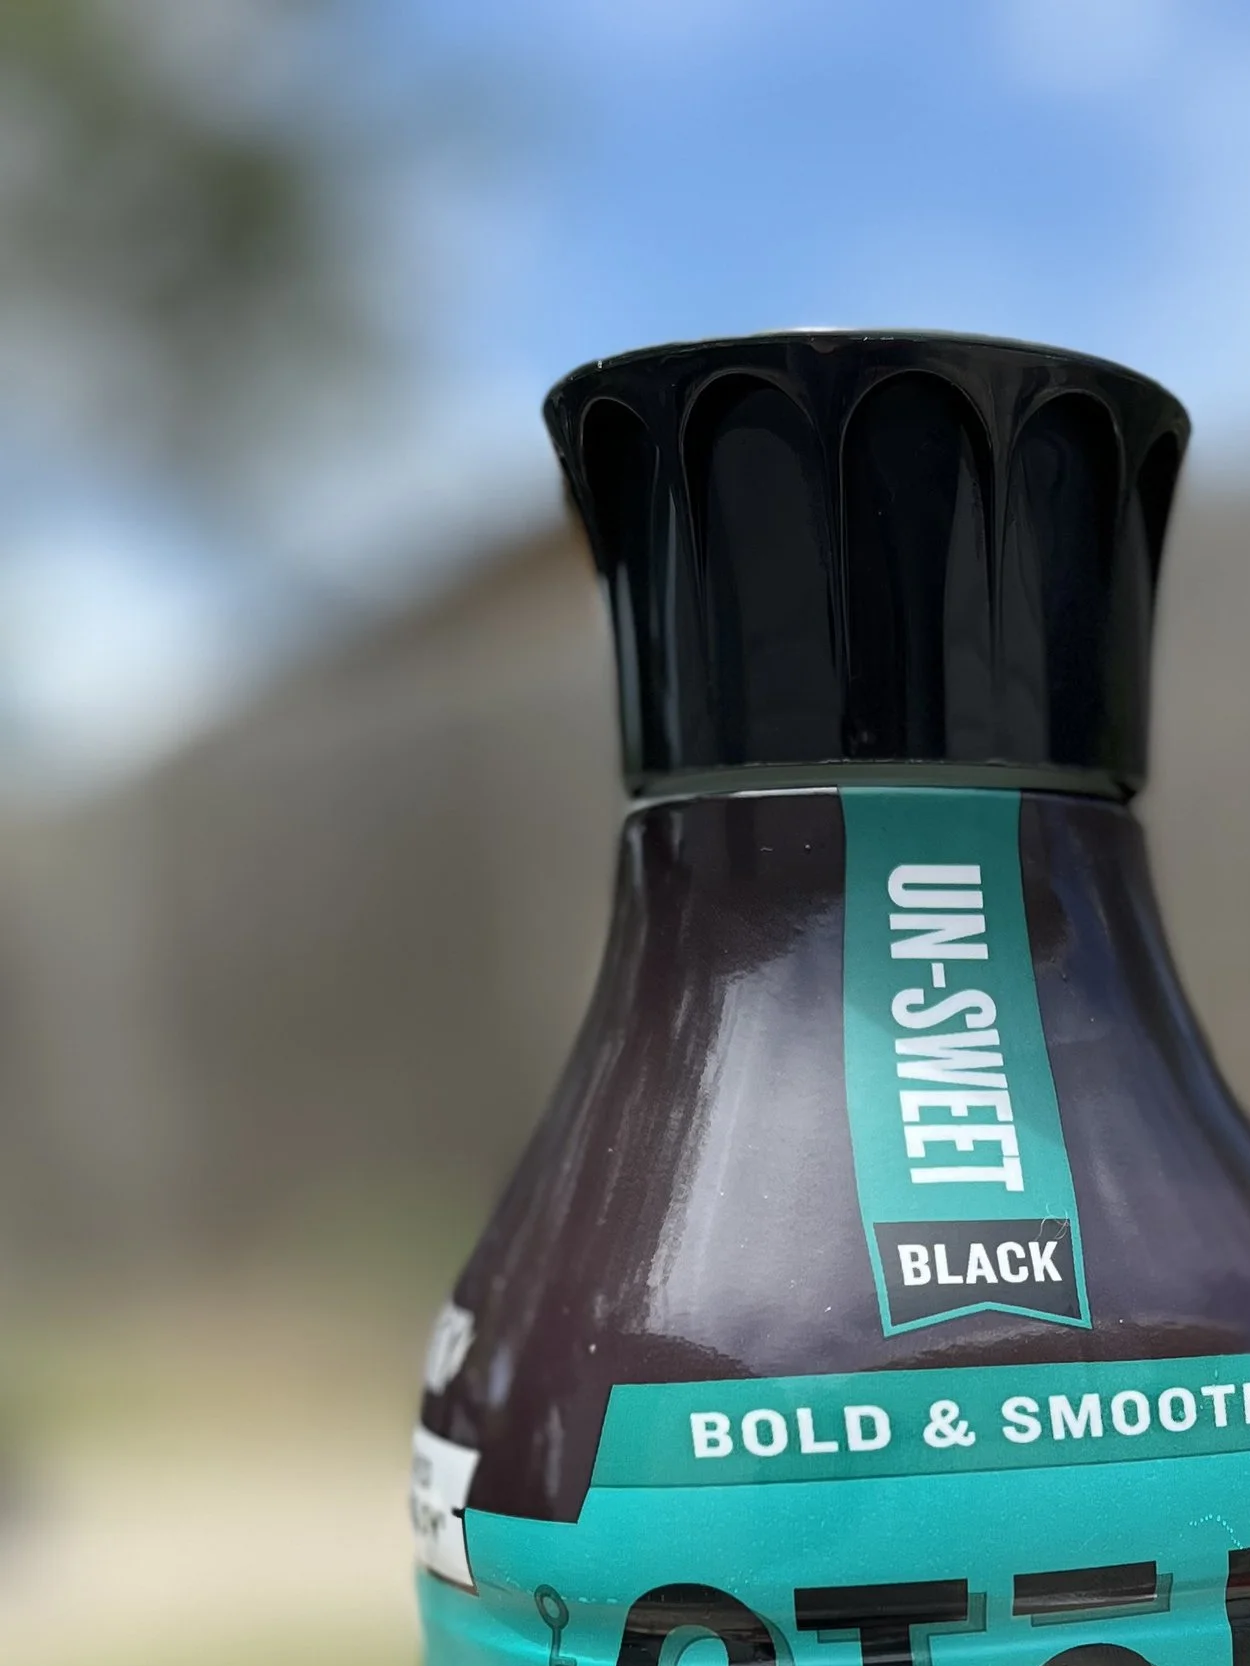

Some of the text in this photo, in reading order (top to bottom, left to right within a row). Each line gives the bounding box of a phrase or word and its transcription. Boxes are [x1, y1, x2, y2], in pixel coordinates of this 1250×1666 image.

[888, 864, 1025, 1192] UN-SWEET
[897, 1240, 1063, 1286] BLACK
[690, 1404, 891, 1459] BOLD
[923, 1399, 976, 1449] &
